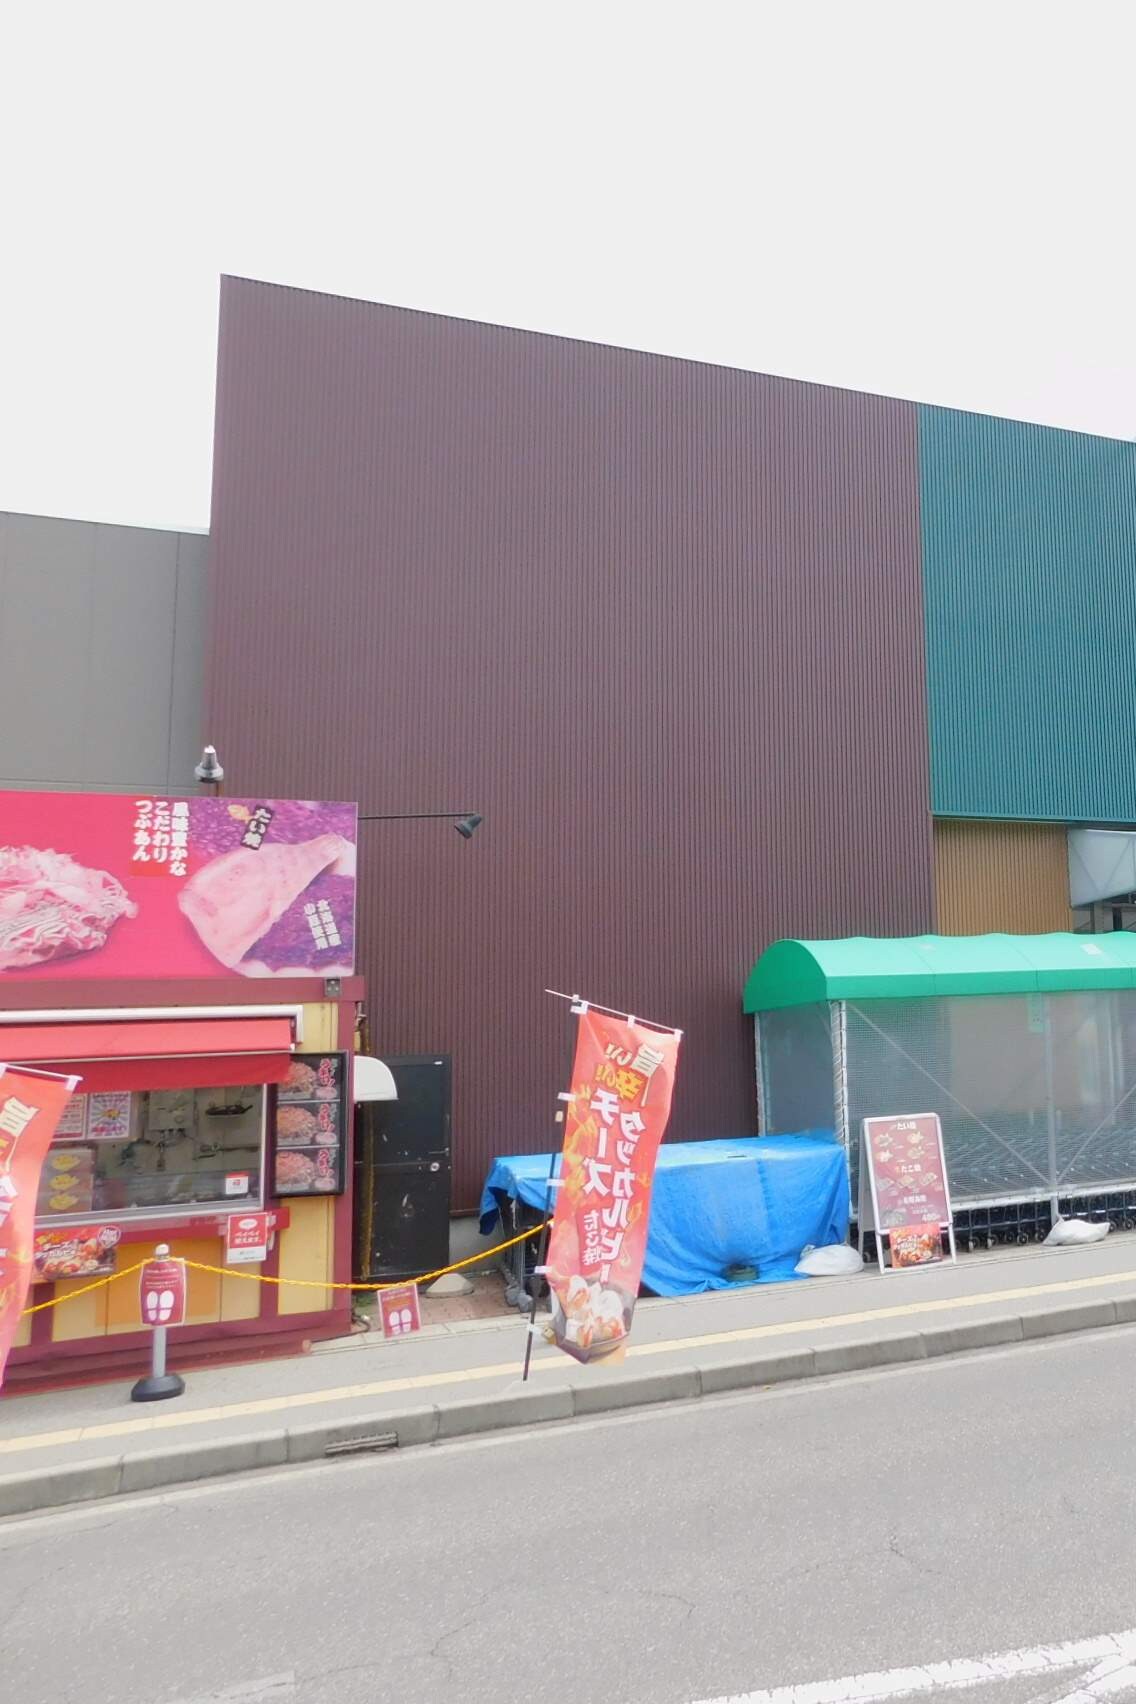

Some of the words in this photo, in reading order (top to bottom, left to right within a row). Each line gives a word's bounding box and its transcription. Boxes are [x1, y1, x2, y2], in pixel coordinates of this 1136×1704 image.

[132, 800, 153, 861] つぶあん
[152, 801, 170, 863] こだわり
